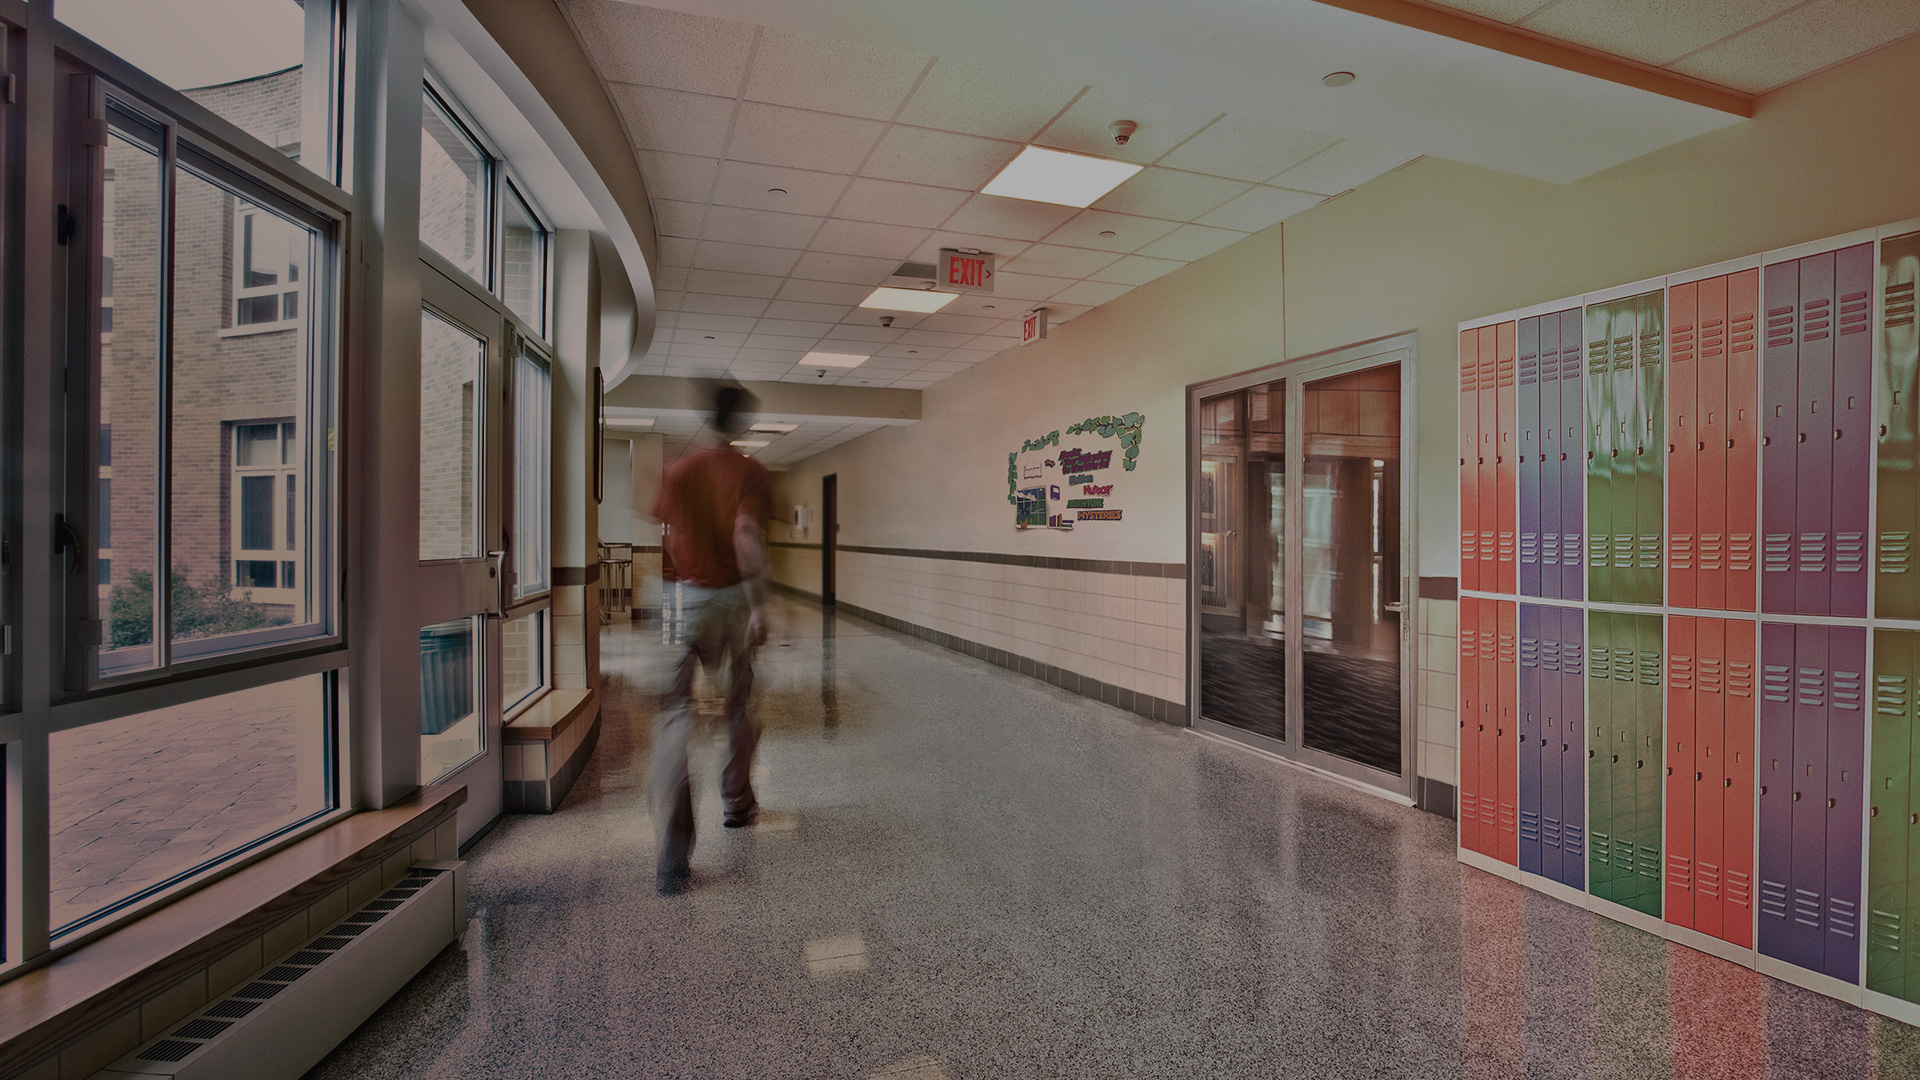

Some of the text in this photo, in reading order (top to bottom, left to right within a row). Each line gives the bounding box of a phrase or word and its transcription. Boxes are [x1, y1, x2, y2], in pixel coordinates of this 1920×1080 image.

[950, 256, 985, 287] EXIT
[1023, 316, 1037, 342] EXIT
[1066, 498, 1104, 509] ADVENTURE
[1077, 510, 1122, 521] MYSTERIES
